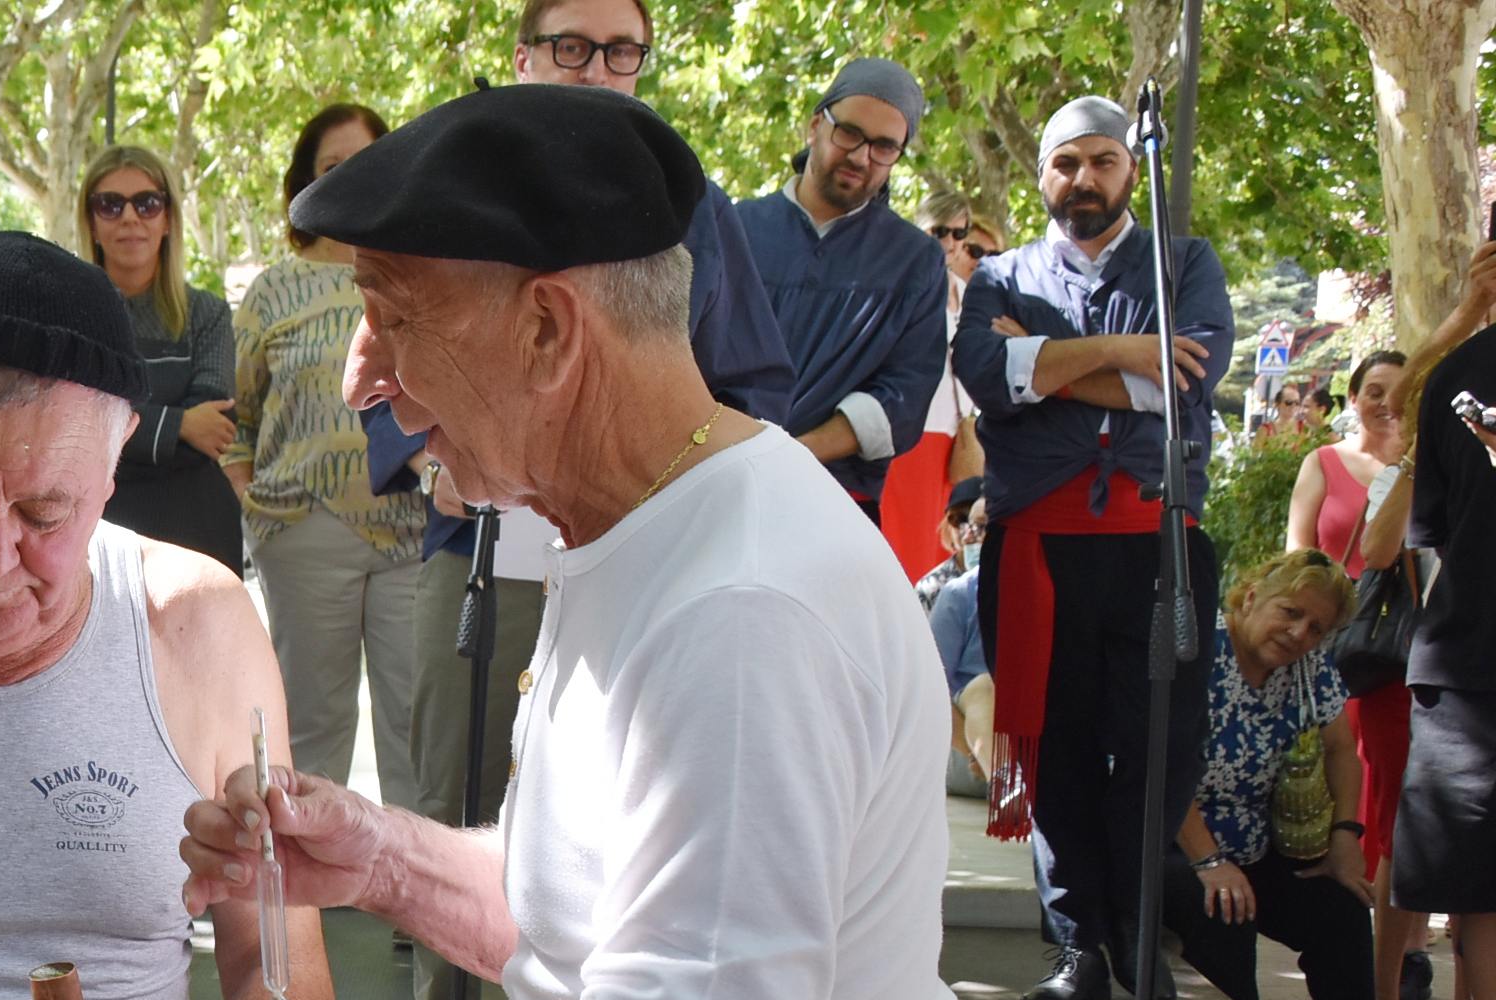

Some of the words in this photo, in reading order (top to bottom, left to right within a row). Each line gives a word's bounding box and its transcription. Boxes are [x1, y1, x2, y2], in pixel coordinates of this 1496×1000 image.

[30, 765, 82, 799] JEANS
[87, 760, 140, 798] SPORT
[56, 840, 128, 853] QUALLITY
